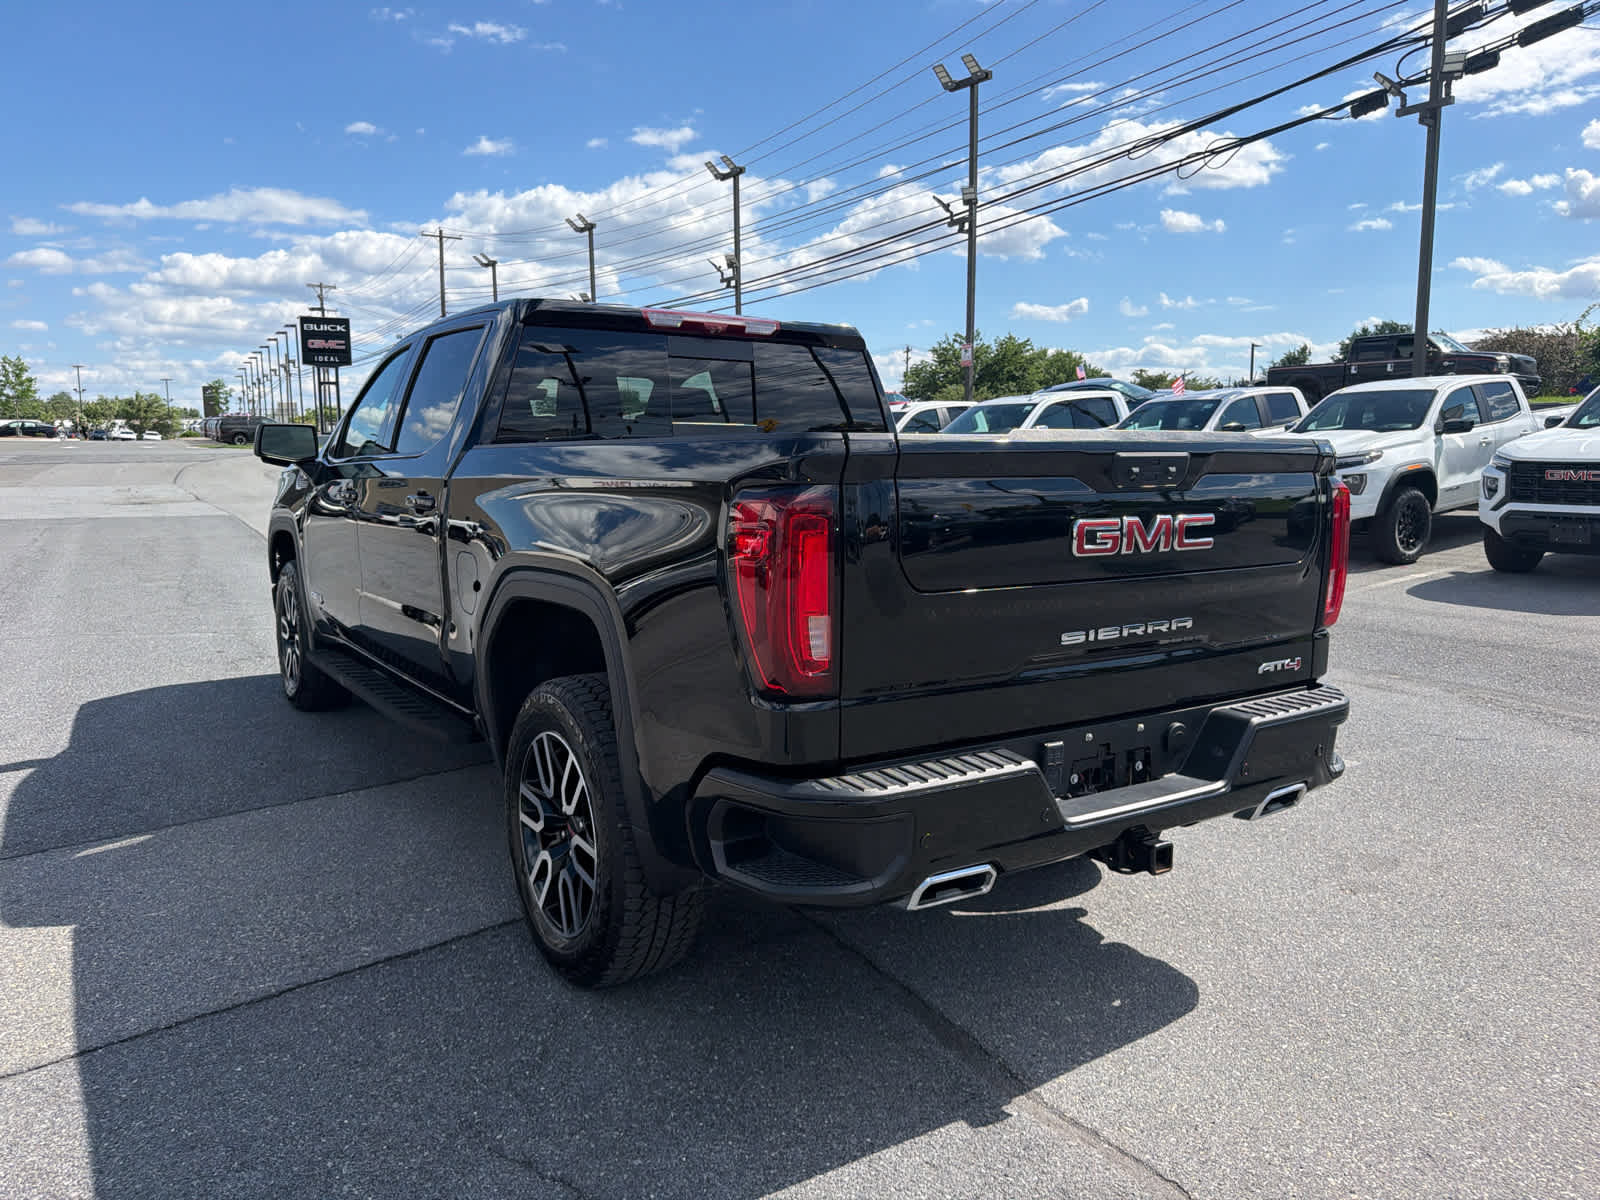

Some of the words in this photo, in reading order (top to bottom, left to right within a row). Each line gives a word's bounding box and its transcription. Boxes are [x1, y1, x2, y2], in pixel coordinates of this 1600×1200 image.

[303, 323, 346, 332] BUICK
[307, 339, 346, 350] GMC
[1545, 469, 1600, 481] GMC
[1072, 513, 1215, 557] GMC
[1060, 617, 1193, 645] SIERRA
[1257, 656, 1302, 675] AT4
